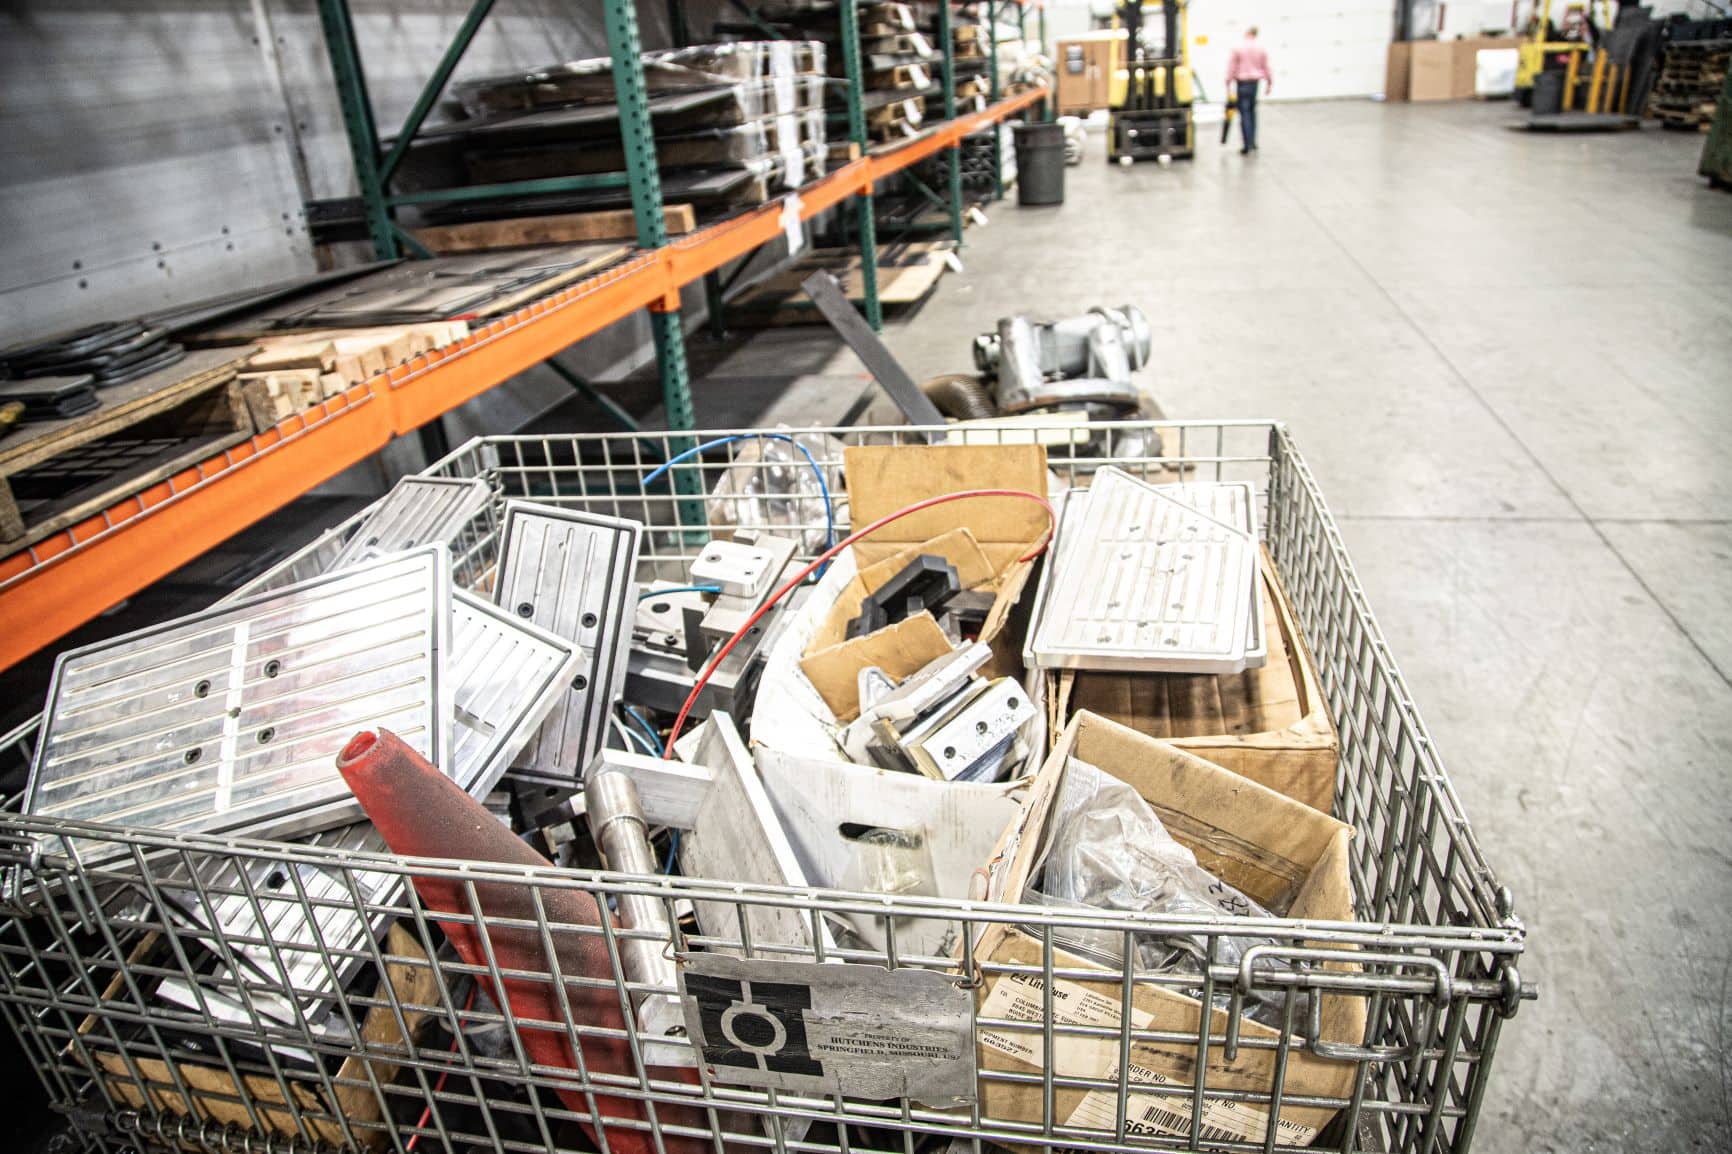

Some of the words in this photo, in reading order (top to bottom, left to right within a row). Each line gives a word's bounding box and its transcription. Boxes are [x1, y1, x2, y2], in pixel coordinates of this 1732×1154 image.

[831, 1037, 885, 1049] HUTCHENS
[887, 1042, 949, 1053] INDUSTRIES
[1128, 1063, 1152, 1078] RDER
